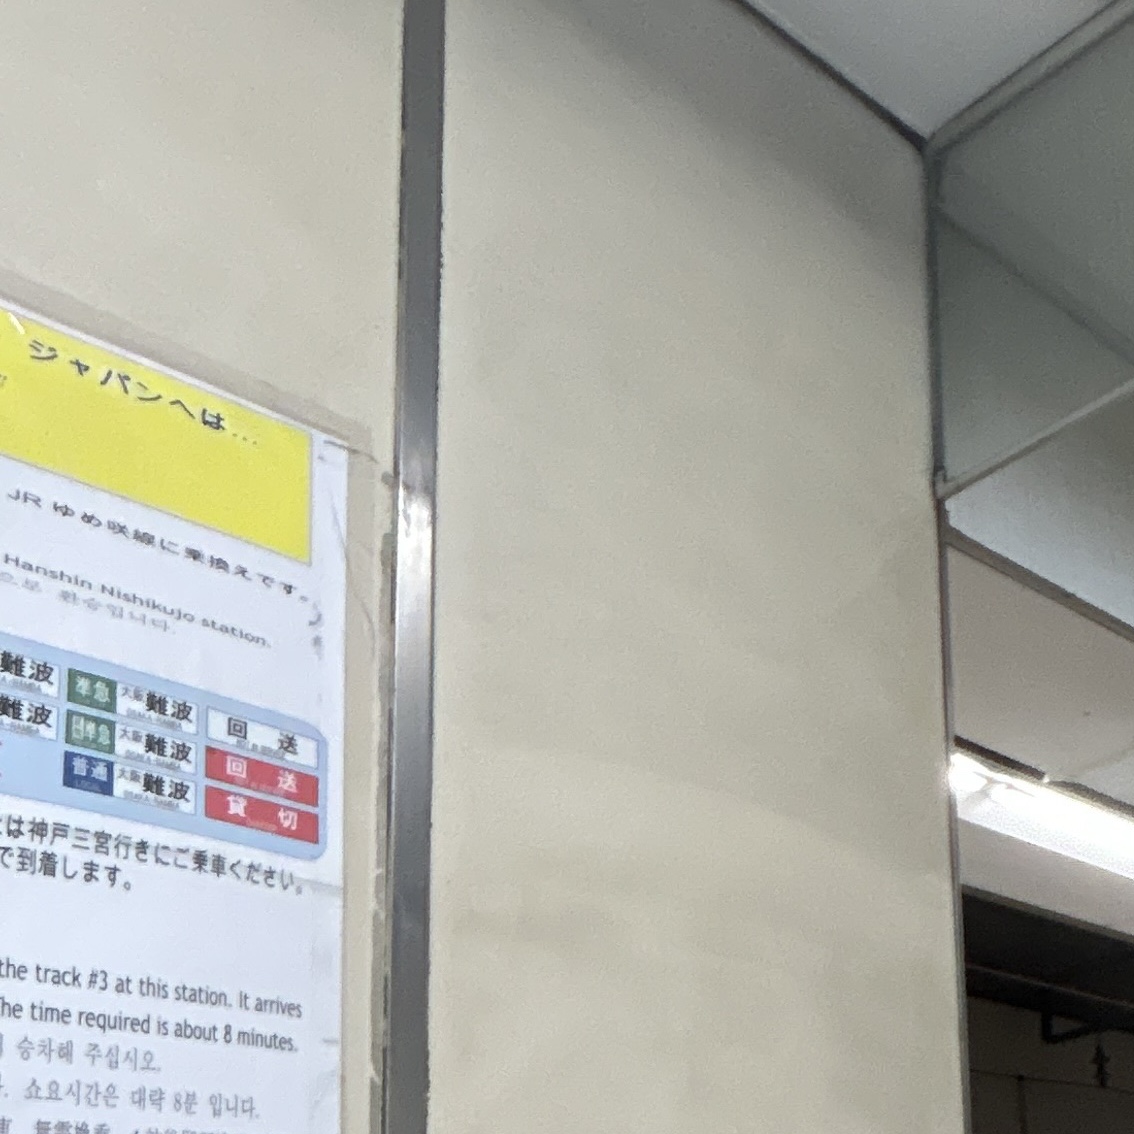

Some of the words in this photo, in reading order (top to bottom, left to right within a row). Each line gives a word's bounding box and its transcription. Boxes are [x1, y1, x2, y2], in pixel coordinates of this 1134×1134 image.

[4, 553, 92, 591] Hanshin
[101, 584, 195, 622] Nishikujo
[35, 964, 82, 988] track
[88, 969, 108, 992] #3
[115, 976, 132, 995] at
[139, 977, 168, 999] this
[174, 983, 232, 1009] station.
[239, 990, 250, 1012] It
[254, 996, 302, 1019] arrives
[30, 1000, 71, 1024] time
[78, 1011, 151, 1034] required
[157, 1017, 168, 1036] is
[174, 1019, 218, 1042] about
[223, 1024, 232, 1044] 8
[237, 1028, 298, 1052] minutes.
